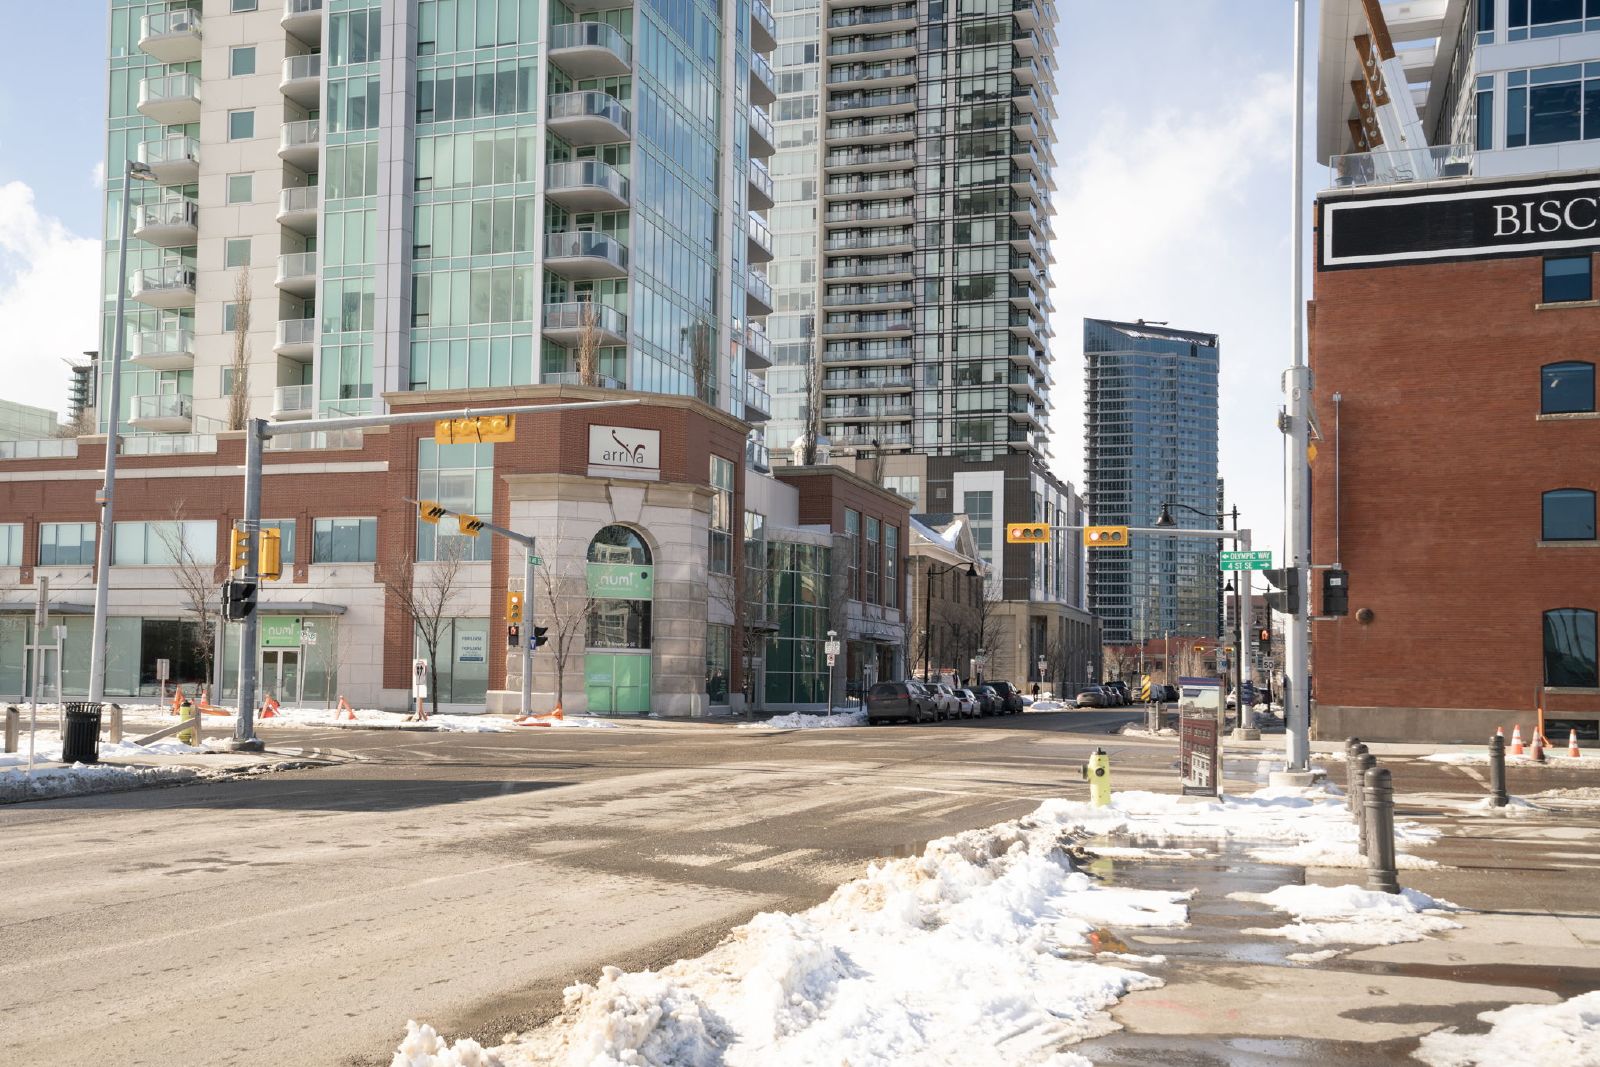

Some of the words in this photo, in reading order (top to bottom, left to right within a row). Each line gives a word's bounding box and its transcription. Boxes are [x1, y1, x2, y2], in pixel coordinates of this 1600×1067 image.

[1492, 197, 1600, 237] BISC
[603, 430, 647, 465] arriva
[1230, 552, 1256, 560] OLYMPIC
[1257, 551, 1270, 560] WAY
[600, 572, 634, 586] numi
[268, 623, 295, 636] numi
[1264, 661, 1274, 669] 50
